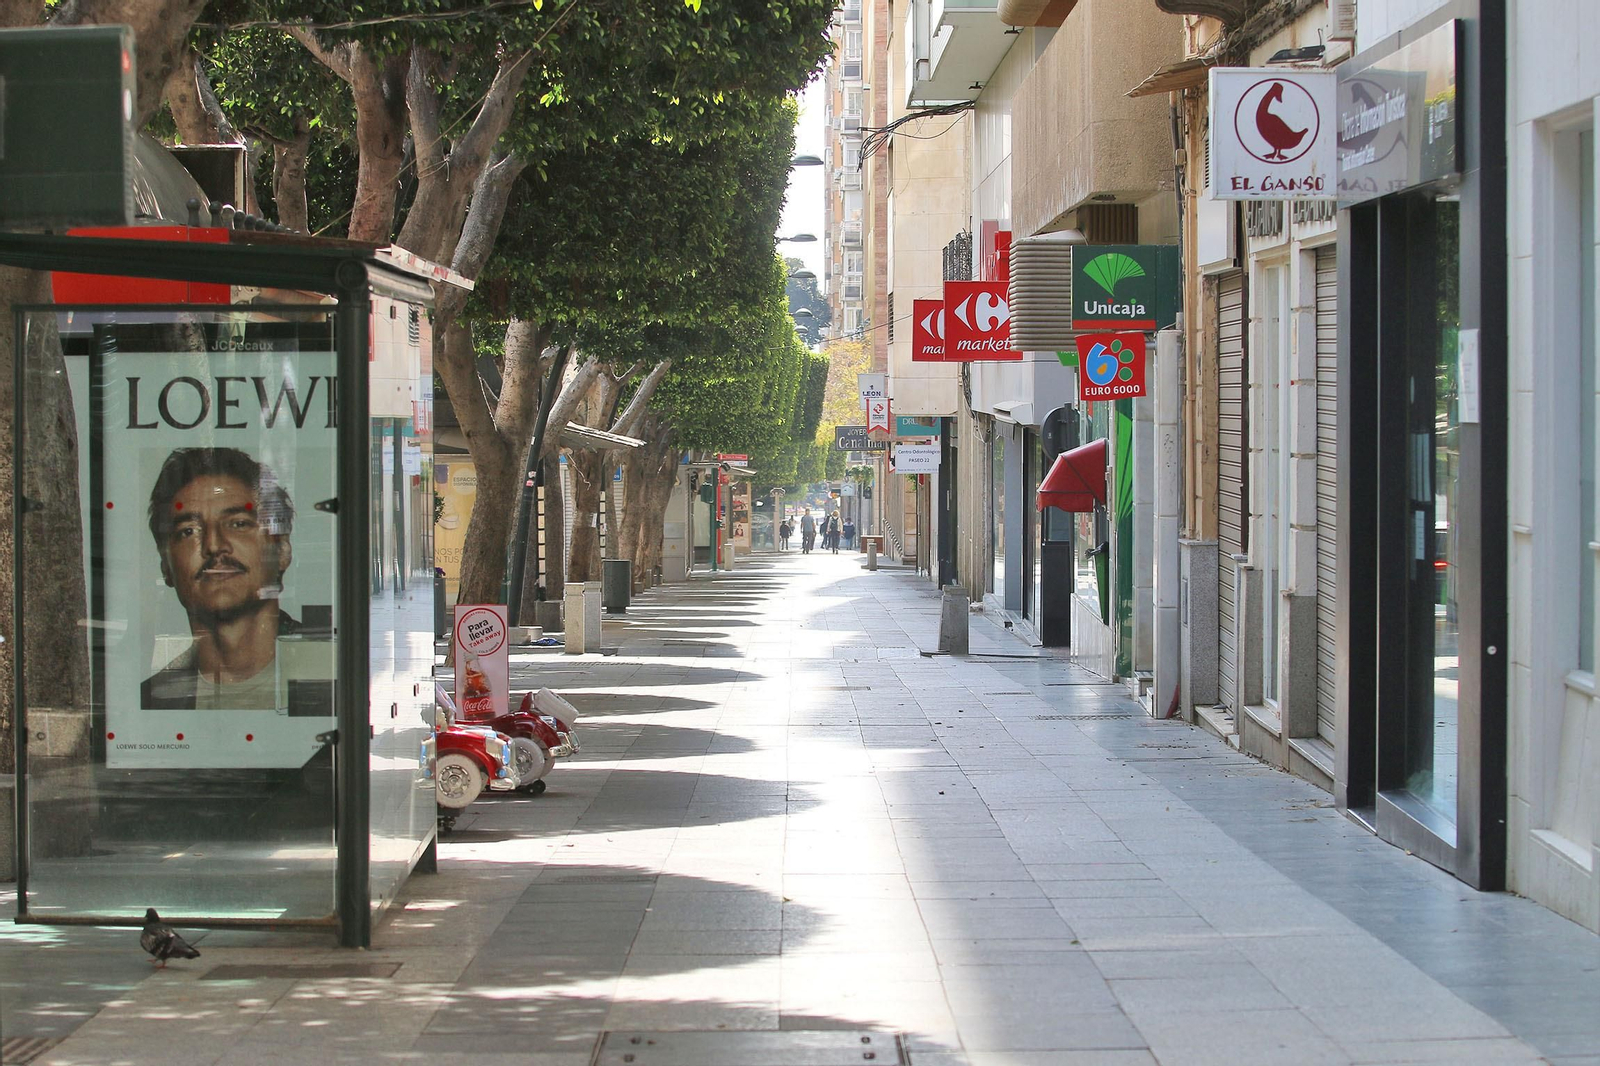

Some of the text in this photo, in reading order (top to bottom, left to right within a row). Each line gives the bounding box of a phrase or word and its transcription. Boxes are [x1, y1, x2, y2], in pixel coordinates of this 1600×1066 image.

[1231, 175, 1325, 192] EL GANSO
[1084, 298, 1146, 318] Unicaja
[211, 341, 274, 351] JCDecaux
[957, 337, 1010, 352] market
[1085, 384, 1140, 396] EURO 6000
[838, 436, 883, 449] Canaima
[467, 619, 489, 633] Para
[468, 625, 494, 641] llevar
[468, 638, 485, 648] Take
[485, 630, 501, 641] away
